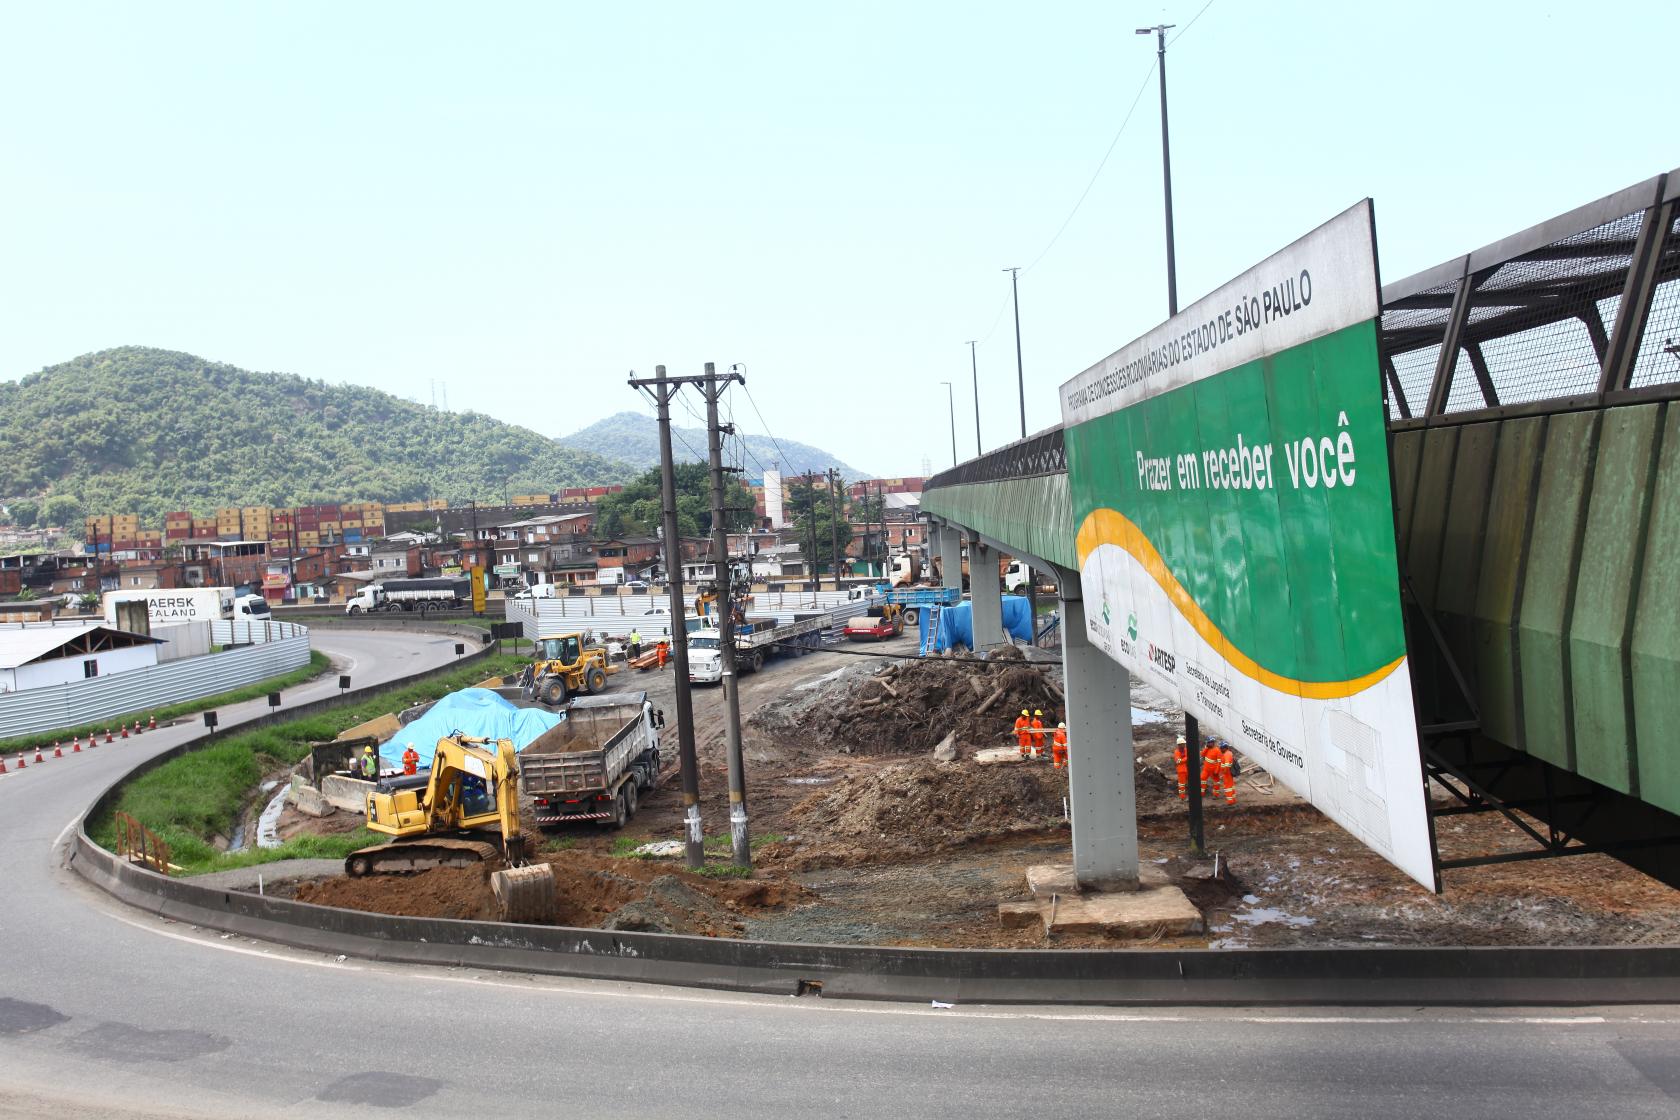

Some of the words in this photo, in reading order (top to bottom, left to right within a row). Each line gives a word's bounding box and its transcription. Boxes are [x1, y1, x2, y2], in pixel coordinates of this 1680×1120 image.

[1168, 339, 1180, 367] DO
[1181, 320, 1217, 362] ESTADO
[1218, 310, 1234, 344] DE
[1235, 295, 1260, 335] SÃO
[1262, 268, 1312, 324] PAULO
[1136, 450, 1172, 491] Prazer
[1177, 452, 1200, 490] em
[1202, 433, 1274, 490] receber
[147, 597, 194, 608] AERSK
[148, 608, 196, 617] EALAND
[1154, 646, 1176, 675] ARTESP
[1241, 719, 1269, 748] Secretaria
[1268, 736, 1276, 753] de
[1276, 740, 1304, 769] Governo
